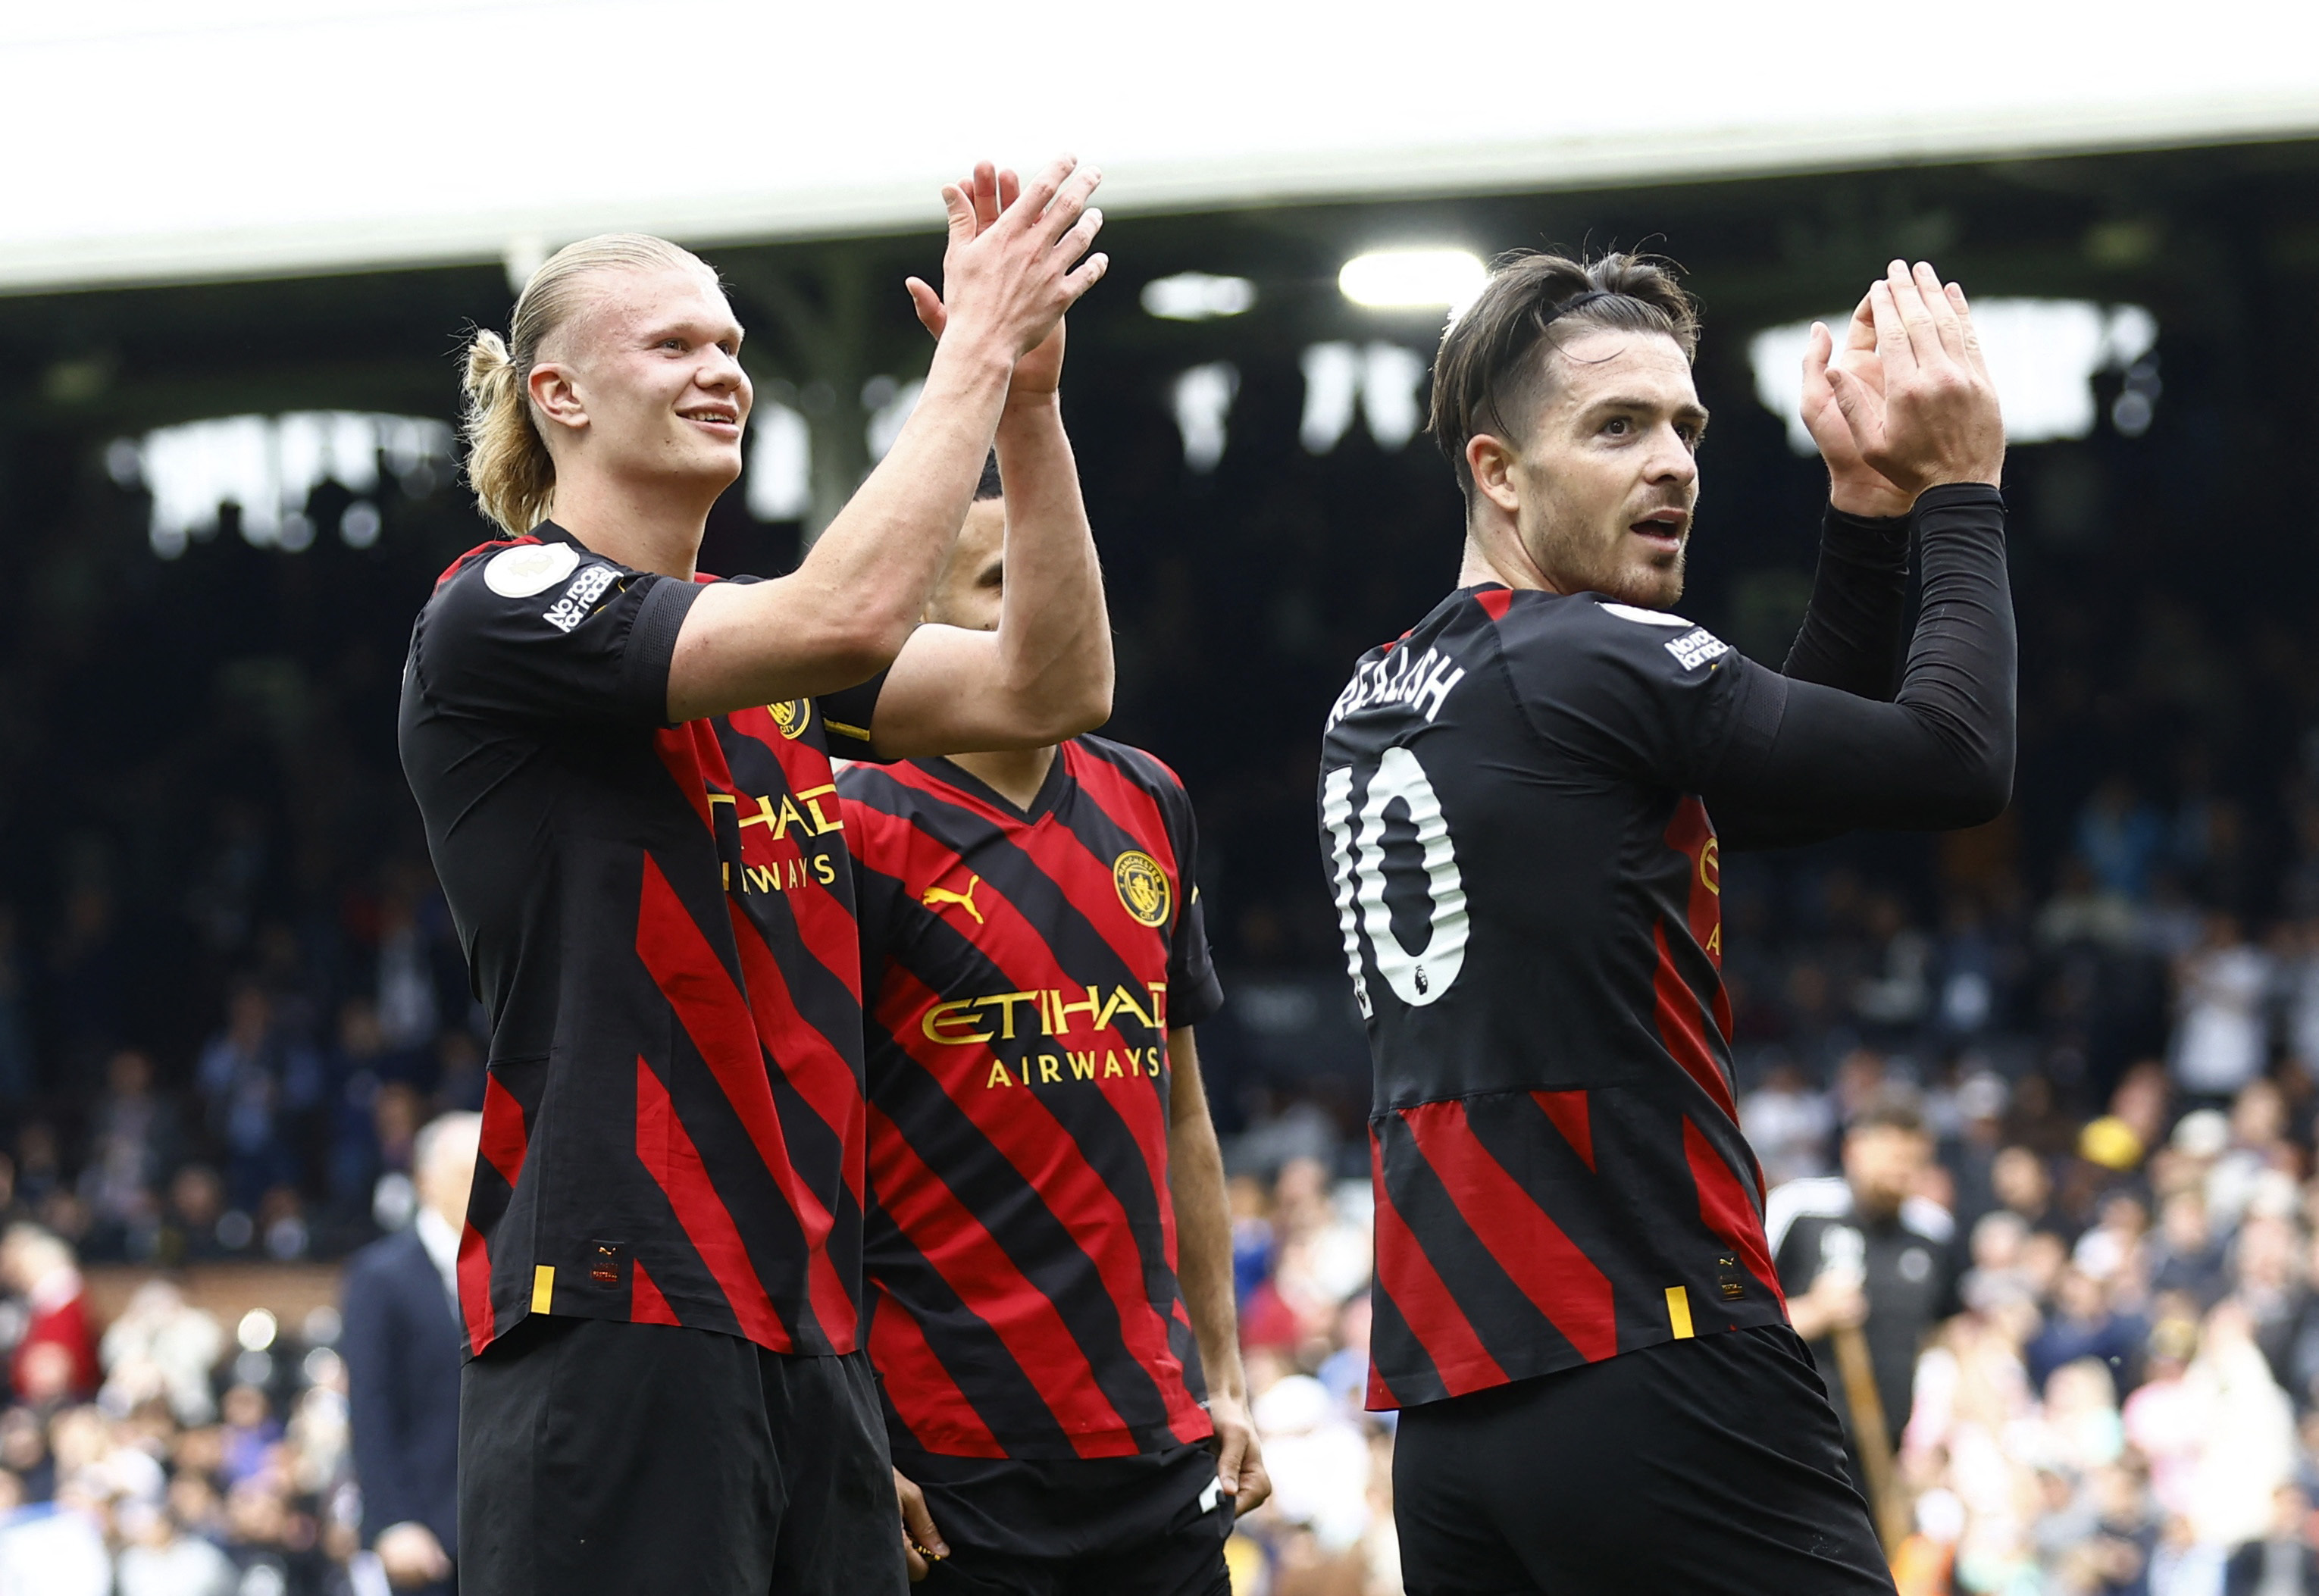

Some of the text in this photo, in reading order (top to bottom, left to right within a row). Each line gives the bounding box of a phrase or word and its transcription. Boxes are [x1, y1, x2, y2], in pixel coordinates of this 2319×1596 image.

[543, 599, 574, 627] No
[558, 606, 584, 633] for
[1664, 638, 1695, 658] No
[1676, 649, 1705, 671] for
[1326, 646, 1466, 733] REALISH
[1322, 746, 1470, 1020] 10
[987, 1047, 1160, 1088] AIRWAYS
